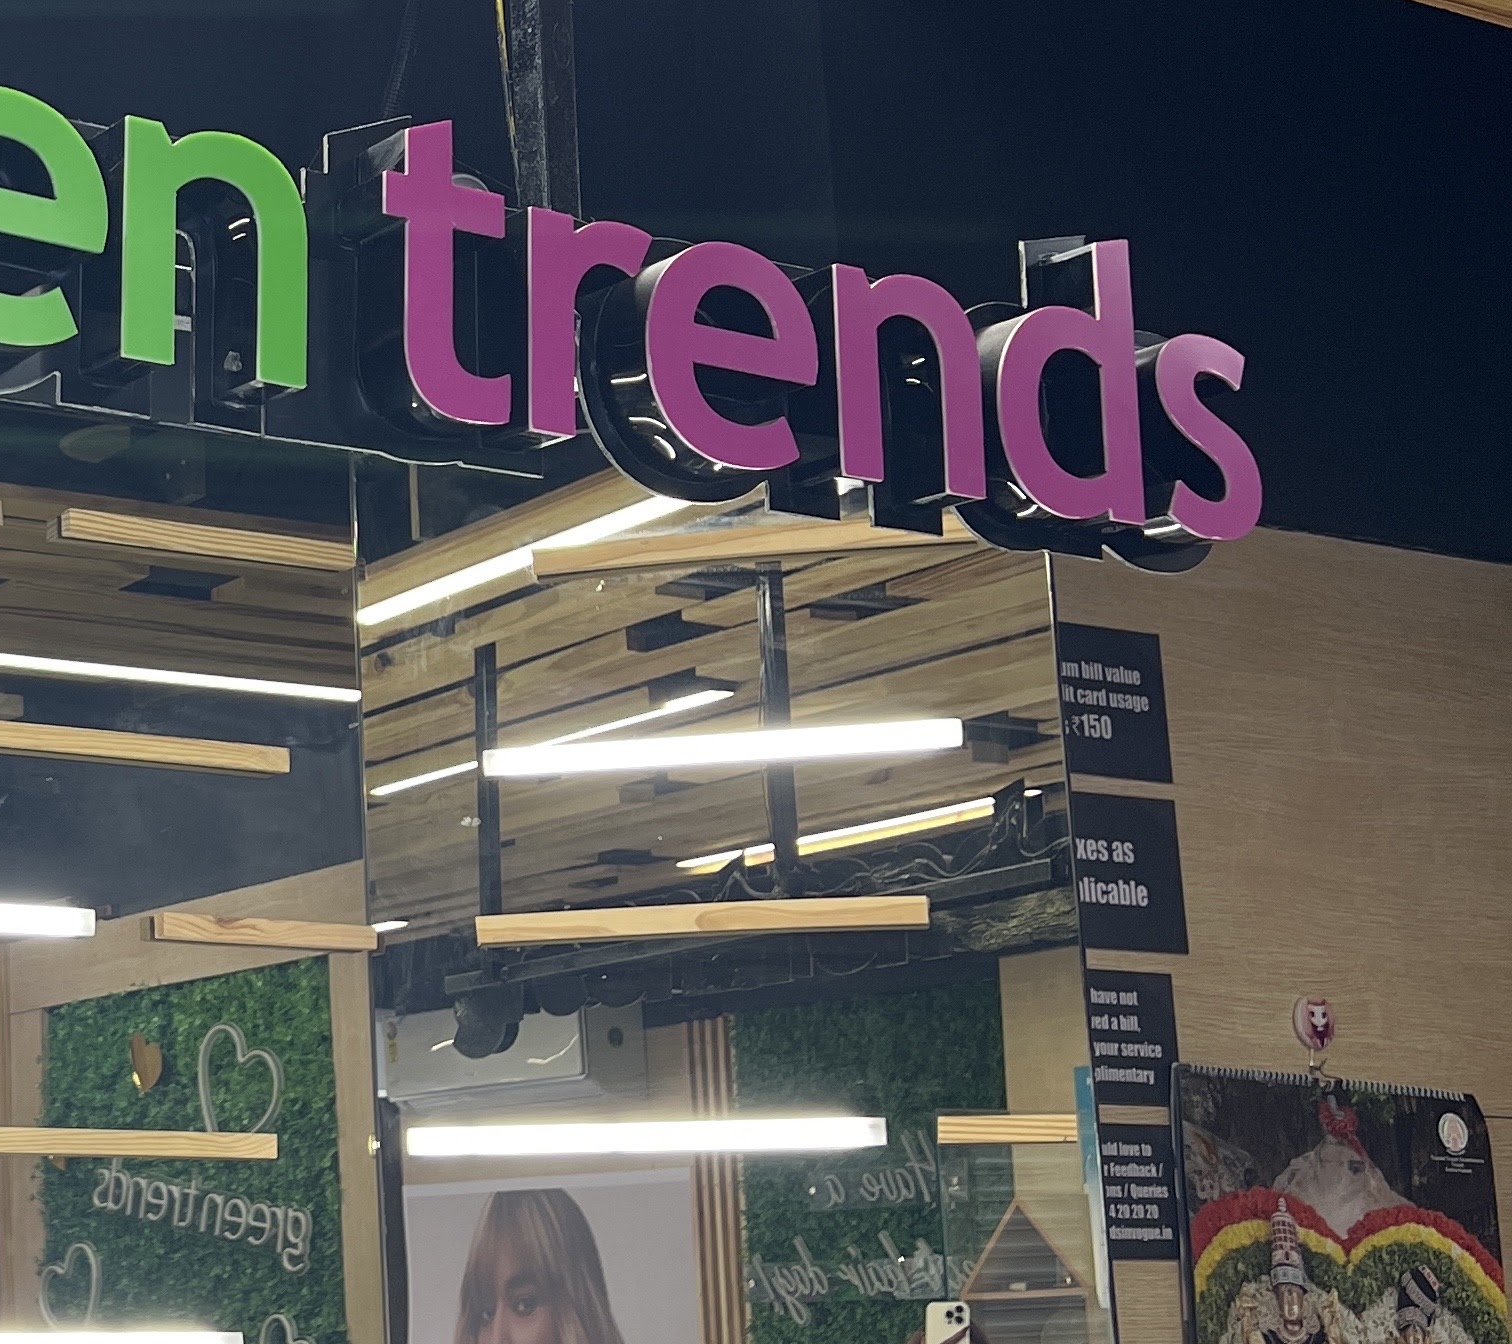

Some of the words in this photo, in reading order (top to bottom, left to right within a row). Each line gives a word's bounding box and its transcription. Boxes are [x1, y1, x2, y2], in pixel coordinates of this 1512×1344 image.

[382, 119, 1263, 541] trends
[1081, 661, 1103, 681] bill
[1105, 666, 1141, 685] value
[1077, 689, 1107, 706] card
[1109, 692, 1149, 712] usage
[1075, 838, 1108, 861] xes
[1112, 841, 1134, 864] as
[1090, 987, 1117, 1005] have
[1119, 991, 1138, 1006] not
[1111, 1017, 1118, 1030] a
[1119, 1015, 1141, 1033] bill,
[1093, 1041, 1119, 1056] your
[1121, 1041, 1162, 1058] service
[1119, 1142, 1140, 1156] love
[1141, 1144, 1152, 1156] to
[1110, 1162, 1157, 1177] Feedback
[1130, 1184, 1168, 1199] Queries
[1117, 1205, 1130, 1218] 20
[1131, 1205, 1144, 1218] 20
[1145, 1205, 1159, 1219] 20
